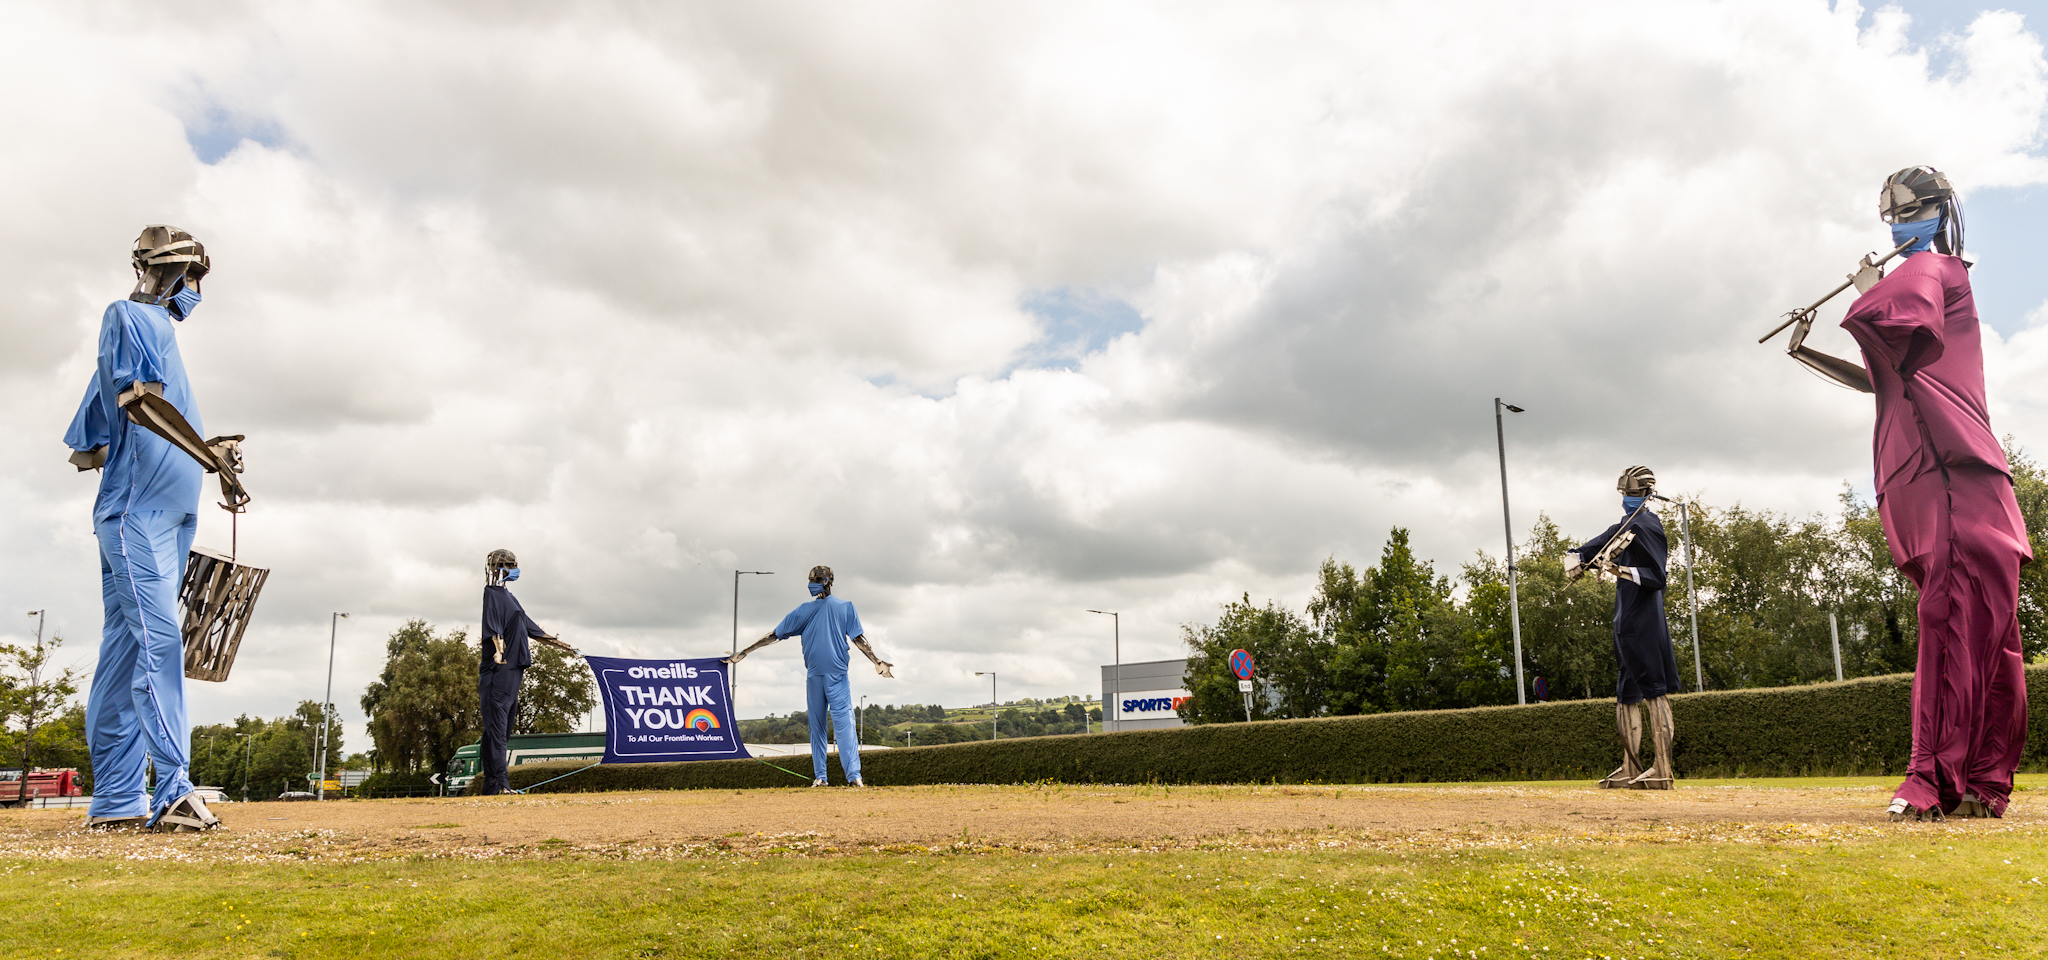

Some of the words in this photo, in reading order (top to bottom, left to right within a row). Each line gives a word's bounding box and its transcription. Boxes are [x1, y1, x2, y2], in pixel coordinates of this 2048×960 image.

[619, 685, 716, 706] THANK
[1122, 697, 1172, 713] SPORTS
[625, 708, 685, 730] YOU
[627, 735, 637, 743] To
[637, 734, 648, 742] All
[648, 735, 663, 743] Our
[664, 734, 695, 742] Frontline
[696, 734, 724, 742] Workers
